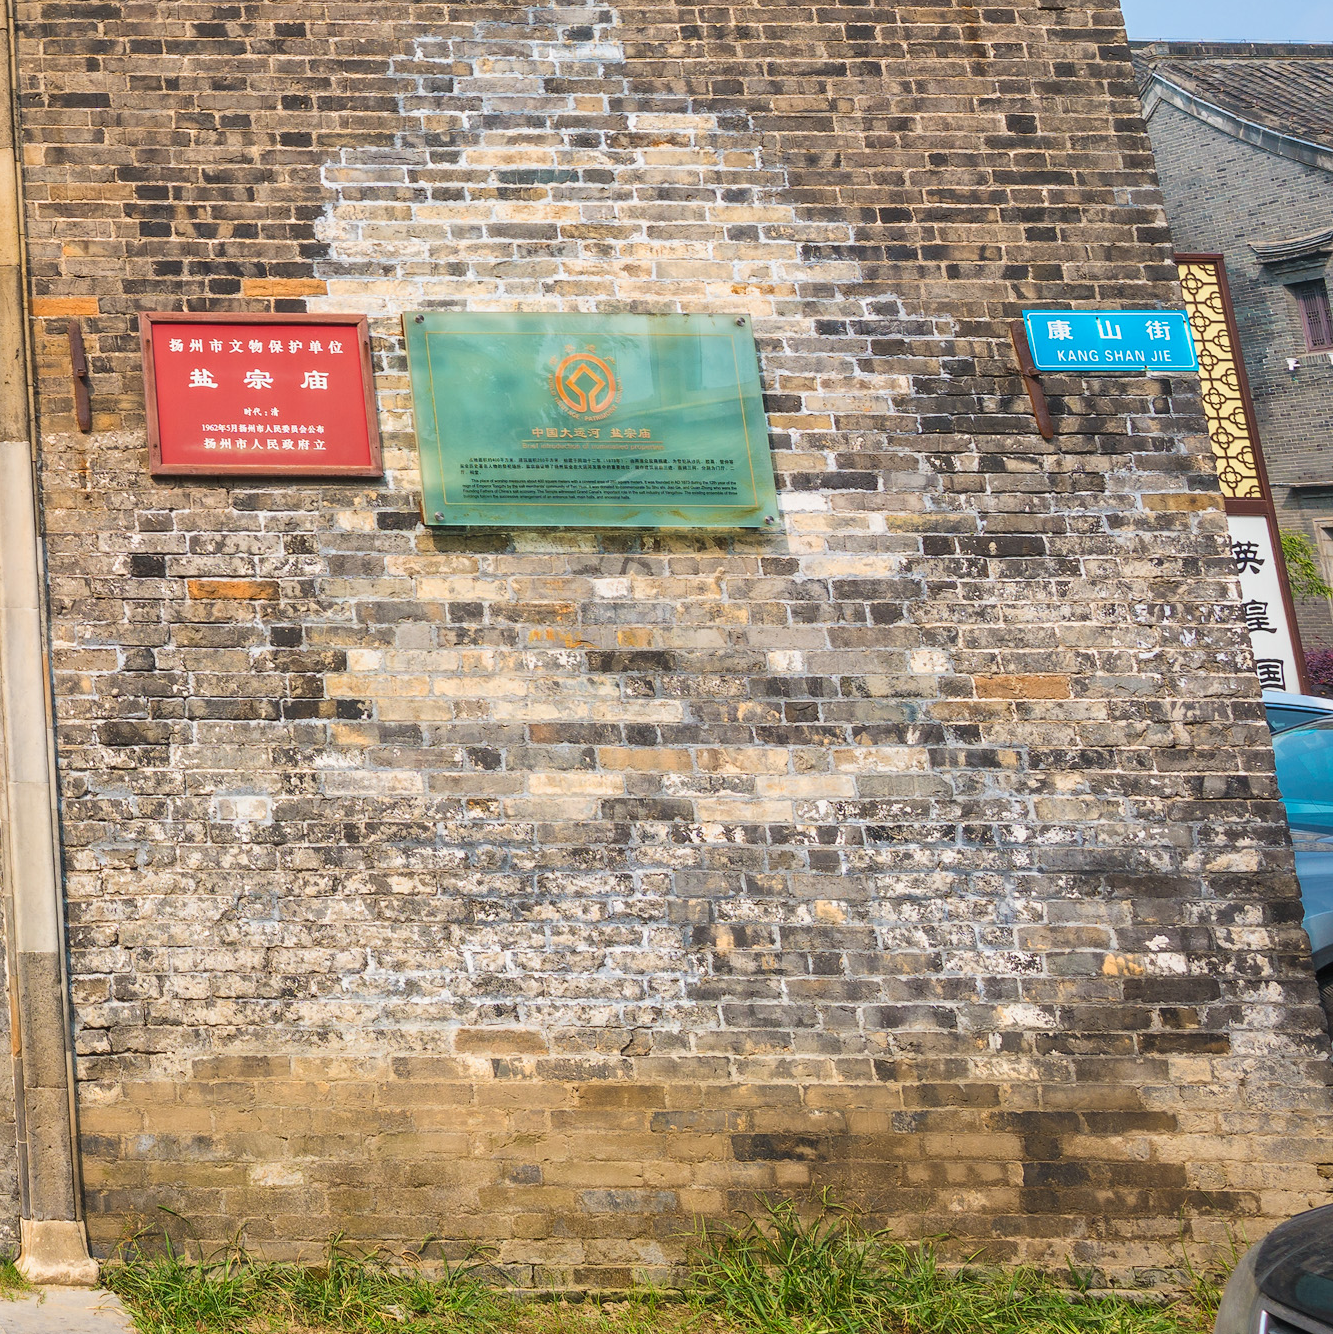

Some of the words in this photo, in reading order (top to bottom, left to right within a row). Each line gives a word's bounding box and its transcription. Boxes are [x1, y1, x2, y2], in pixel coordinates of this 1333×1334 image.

[1047, 319, 1171, 341] 康山街
[169, 338, 344, 355] 扬州市文物保护单位
[1057, 350, 1099, 361] KANG
[1105, 350, 1145, 361] SHAN
[1151, 350, 1172, 361] JIE
[188, 368, 329, 390] 盐宗庙
[202, 423, 325, 434] 1962年5月扬州市人民委员会公布
[532, 427, 600, 438] 中国大运河
[610, 428, 651, 439] 盐宗庙
[204, 438, 326, 451] 扬州市人民政府立
